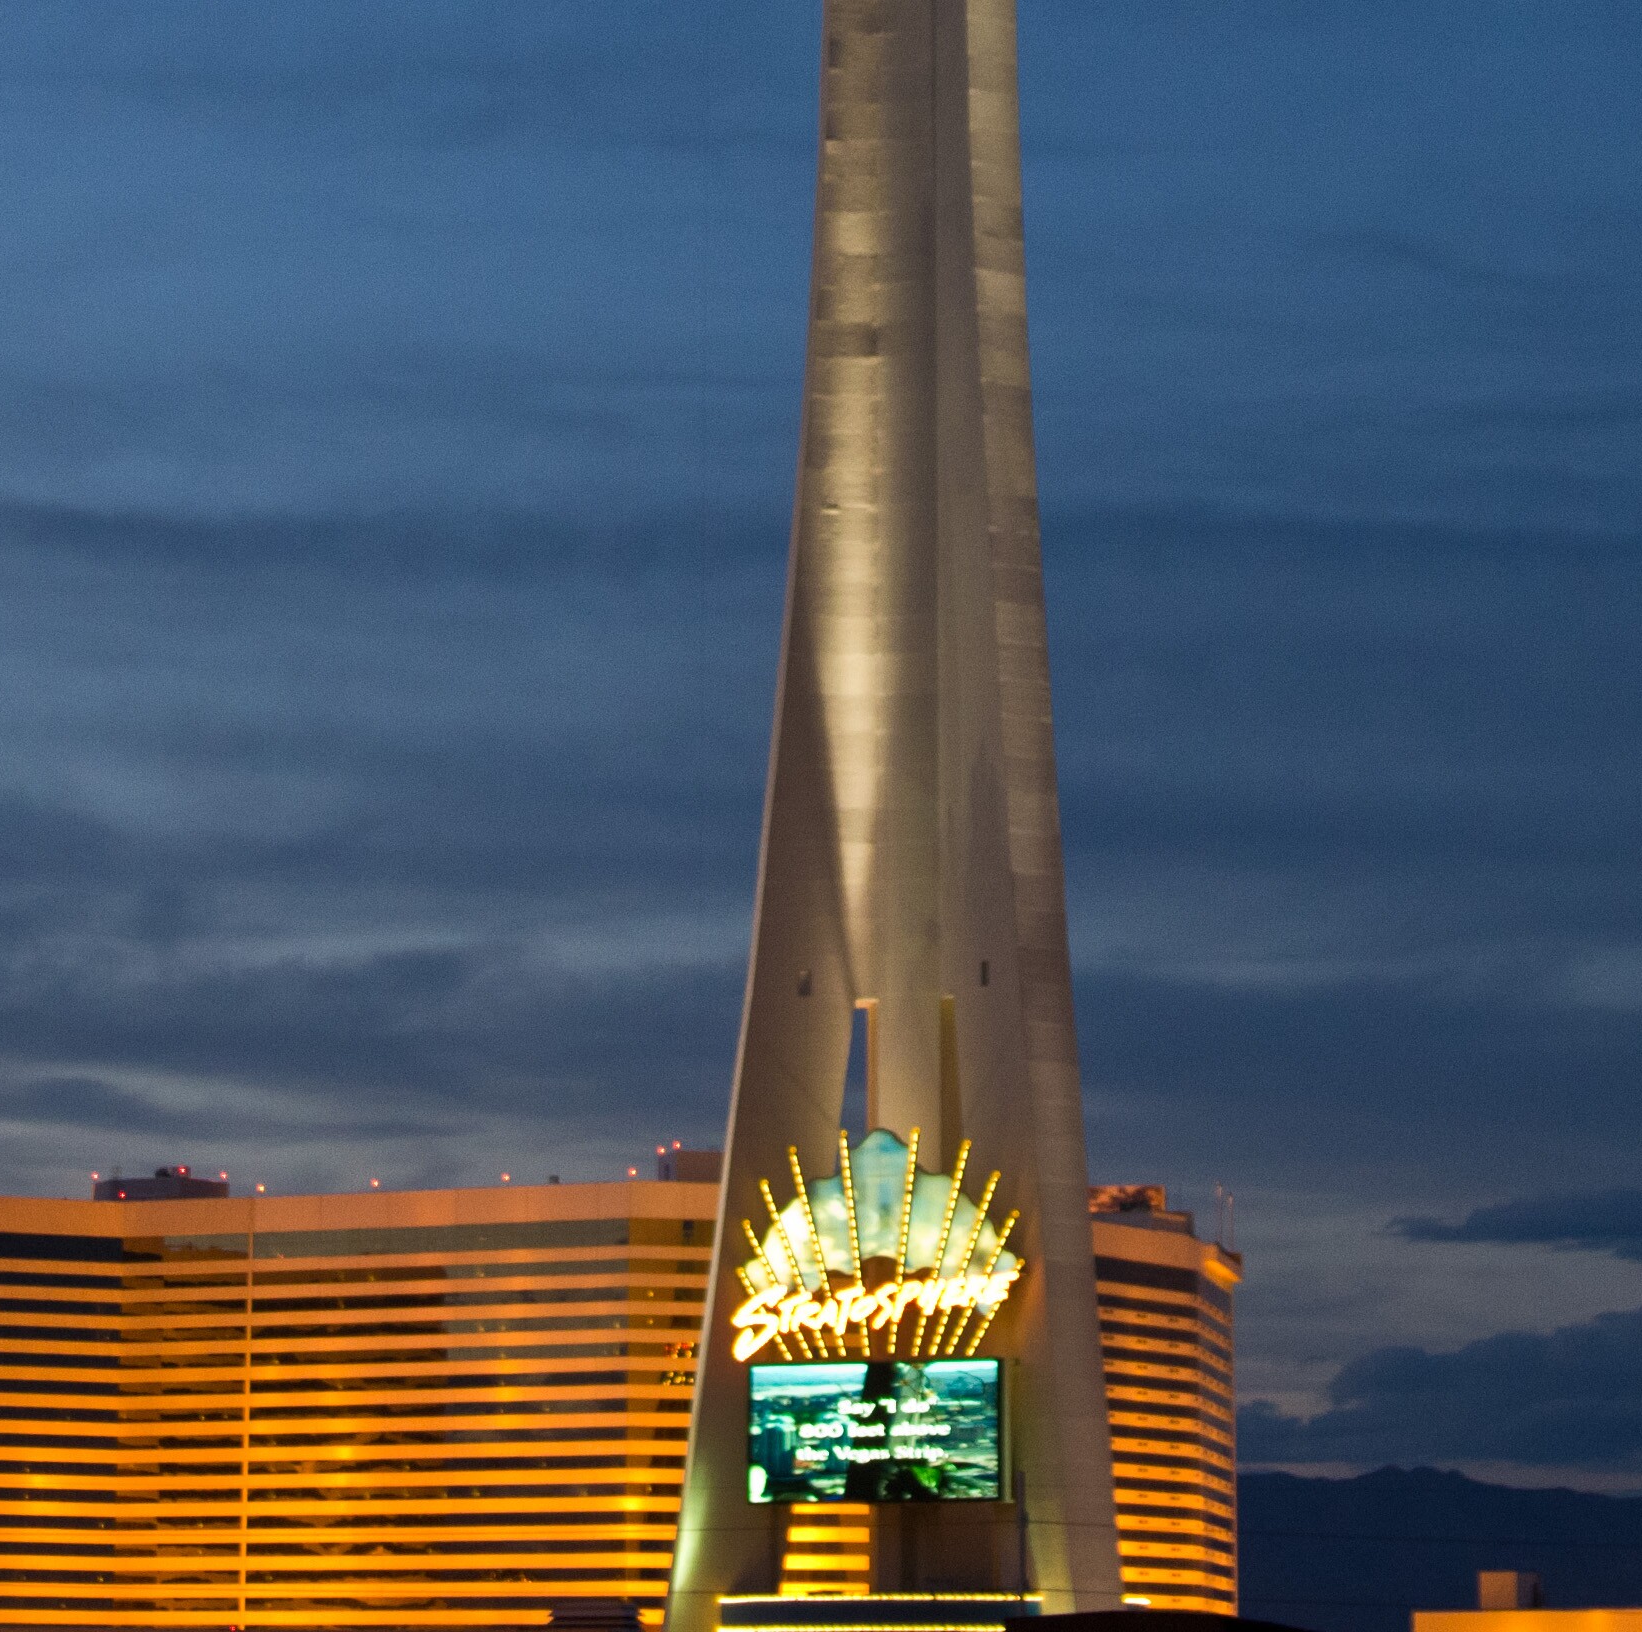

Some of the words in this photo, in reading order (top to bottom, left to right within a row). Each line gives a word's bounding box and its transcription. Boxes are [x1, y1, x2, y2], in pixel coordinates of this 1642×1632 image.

[732, 1271, 1019, 1362] STRATOSPHERE
[837, 1399, 876, 1417] Say
[847, 1422, 886, 1438] feet
[889, 1421, 951, 1436] above
[795, 1446, 829, 1461] the
[832, 1445, 891, 1464] Vegas
[893, 1444, 949, 1462] Strip.
